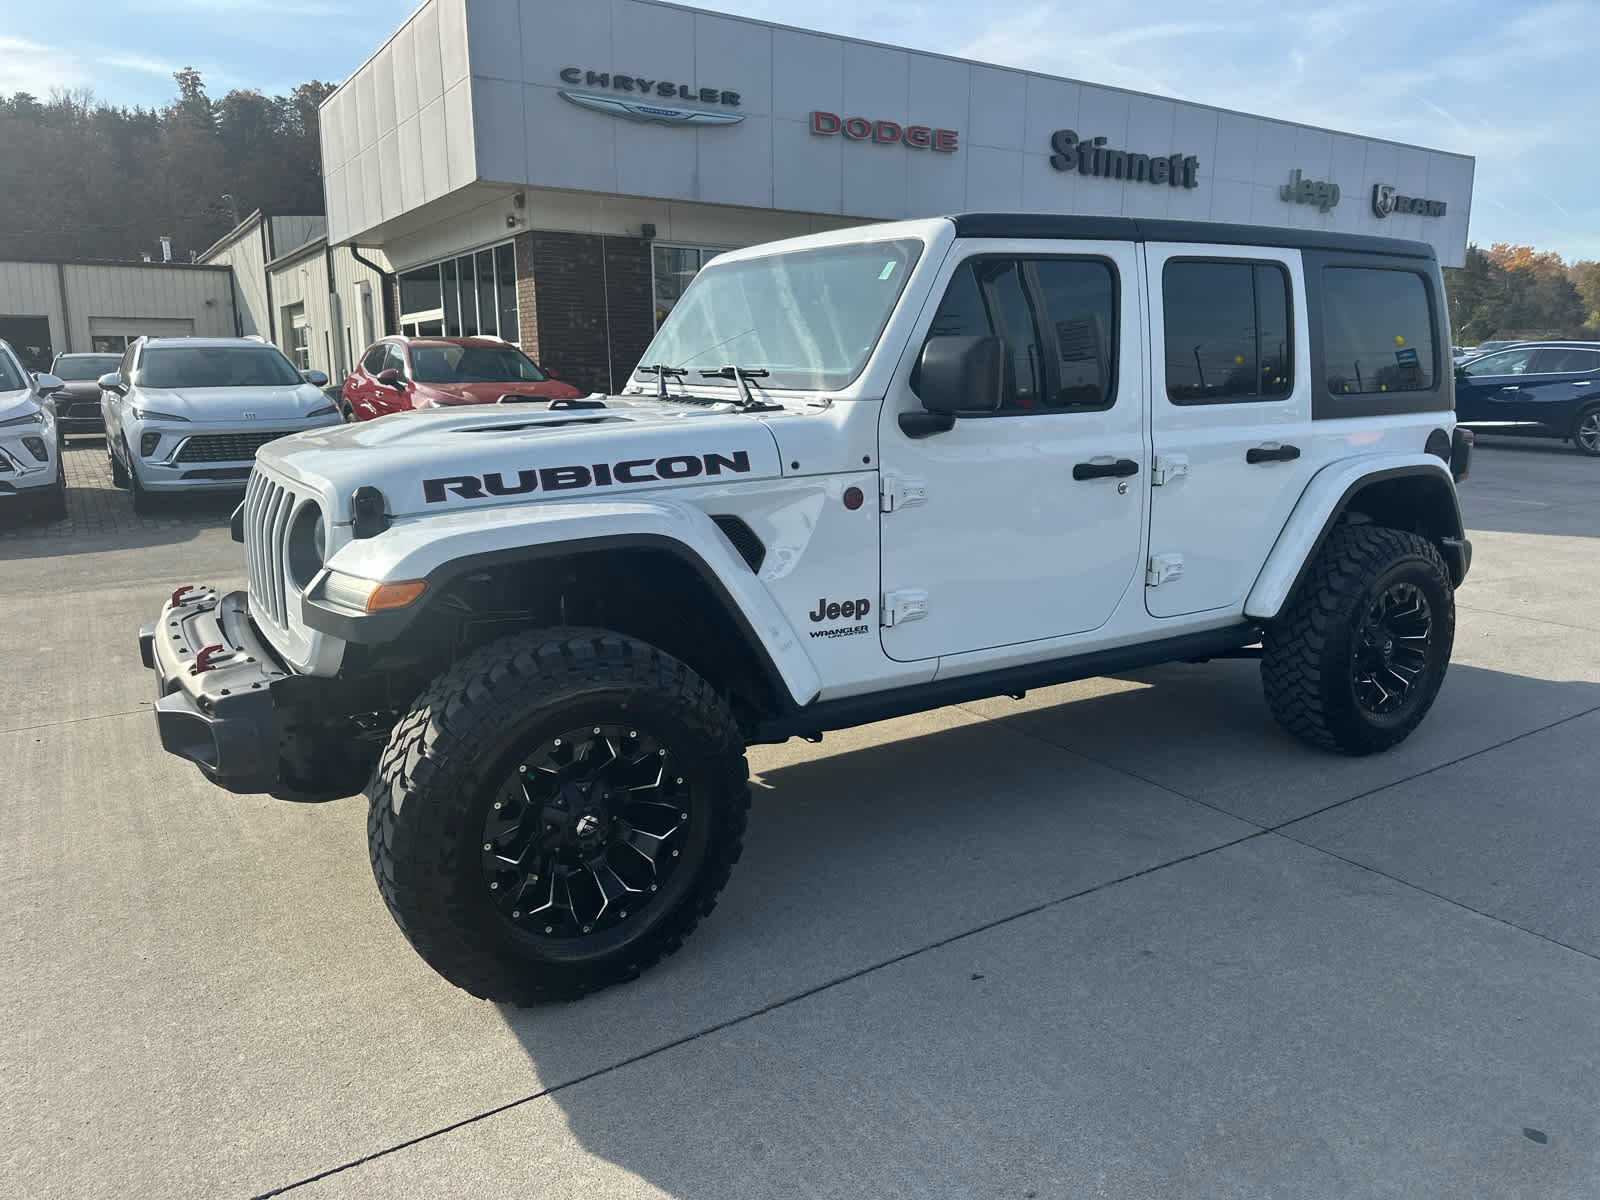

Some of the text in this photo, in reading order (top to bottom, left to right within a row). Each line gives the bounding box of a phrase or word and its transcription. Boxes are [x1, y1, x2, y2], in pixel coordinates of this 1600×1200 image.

[559, 67, 741, 105] CHRYSLER
[810, 111, 959, 152] DODGE
[1050, 129, 1199, 189] Stinnett
[1281, 169, 1340, 214] Jeep
[1395, 195, 1447, 217] RAM
[423, 450, 750, 503] RUBICON
[809, 598, 870, 622] Jeep
[809, 625, 869, 638] WRANGLER
